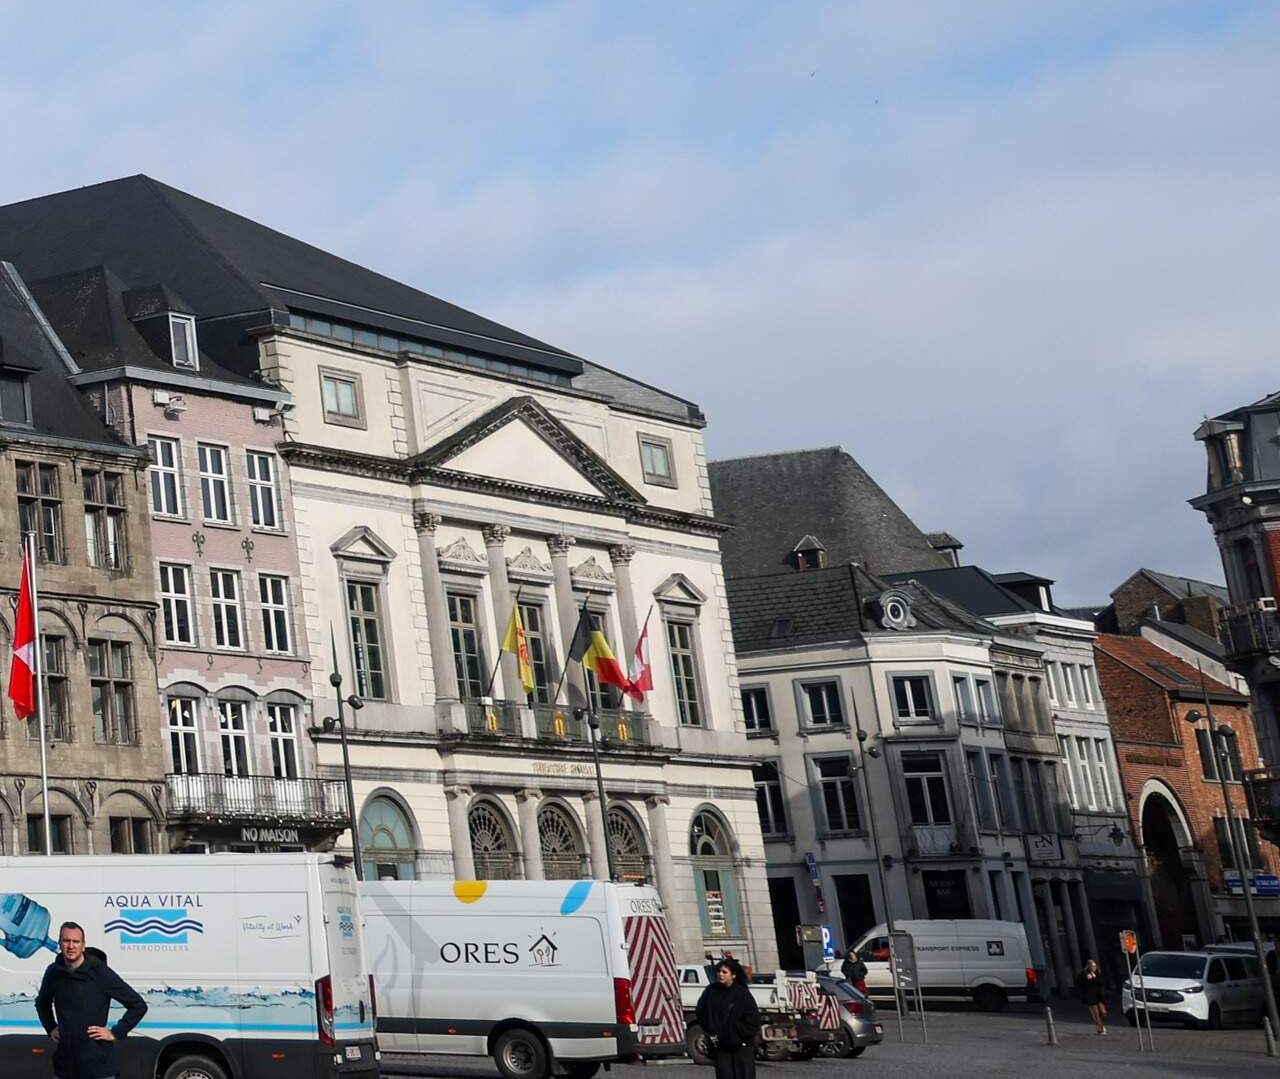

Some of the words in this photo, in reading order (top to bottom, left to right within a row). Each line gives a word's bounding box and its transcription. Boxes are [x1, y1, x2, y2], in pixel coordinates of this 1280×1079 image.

[242, 828, 258, 841] NO
[259, 828, 299, 842] MAISON
[104, 895, 152, 907] AQUA
[159, 895, 203, 907] VITAL
[822, 927, 831, 950] P
[440, 942, 519, 964] ORES
